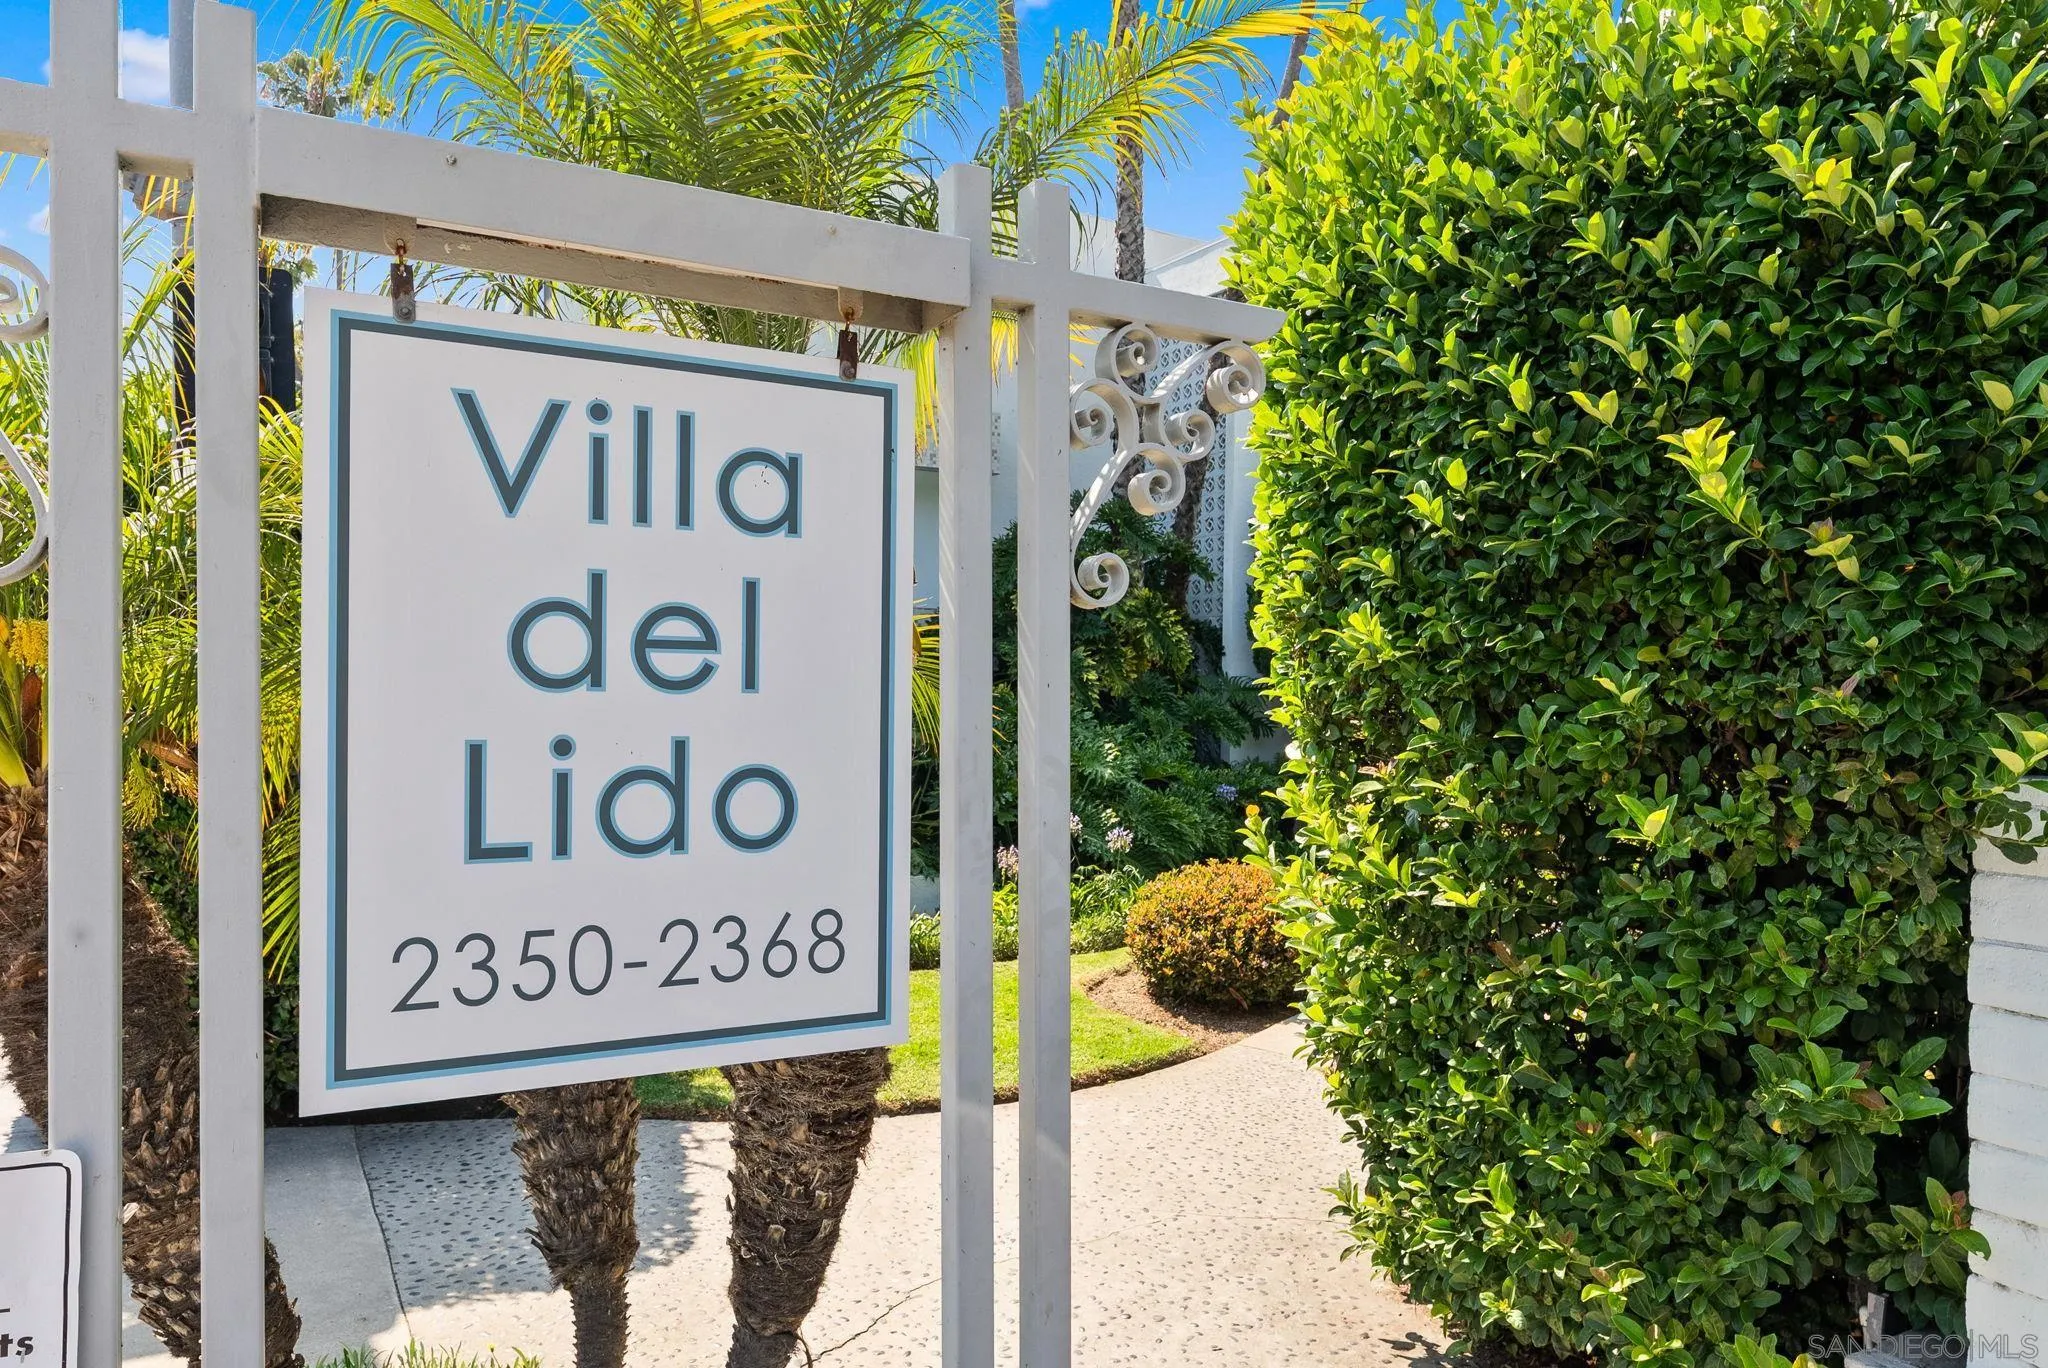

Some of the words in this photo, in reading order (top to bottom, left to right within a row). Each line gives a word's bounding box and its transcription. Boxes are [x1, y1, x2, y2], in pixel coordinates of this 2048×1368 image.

[450, 387, 802, 539] Villa
[507, 569, 760, 693] del
[464, 734, 798, 865] Lido
[391, 908, 845, 1013] 2350-2368
